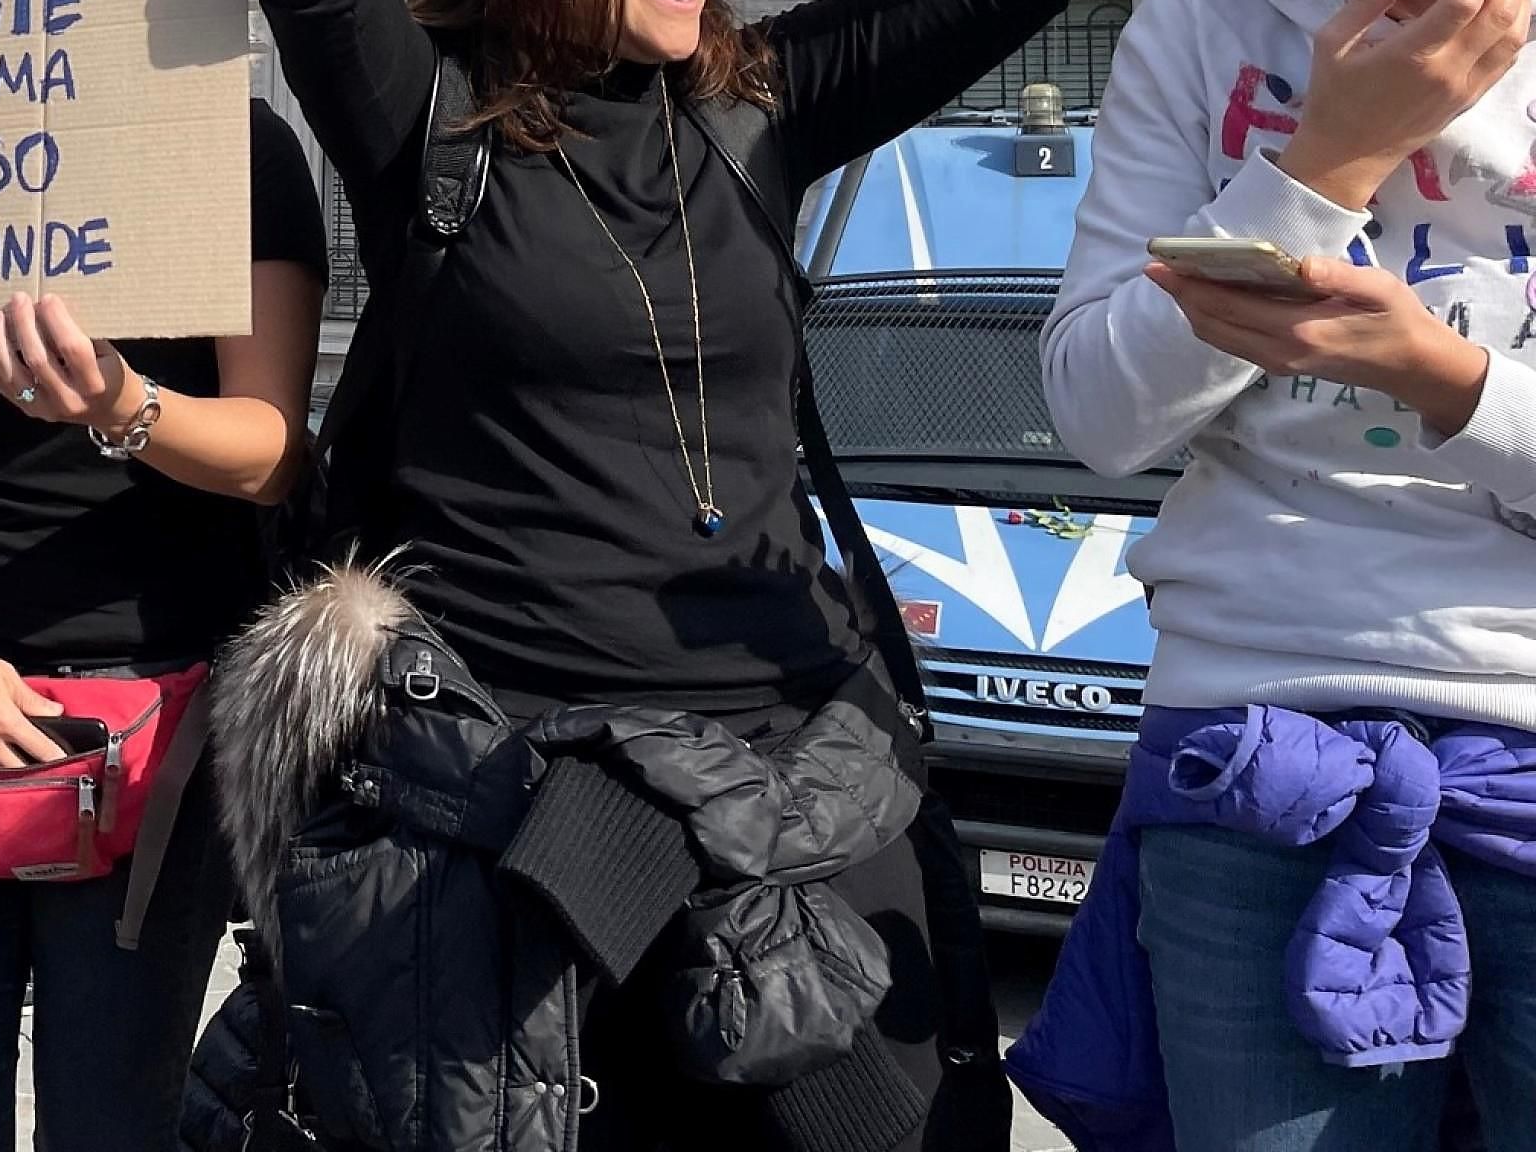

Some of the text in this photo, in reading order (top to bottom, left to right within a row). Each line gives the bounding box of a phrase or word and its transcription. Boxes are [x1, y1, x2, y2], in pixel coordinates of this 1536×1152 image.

[1038, 147, 1053, 170] 2
[976, 674, 1112, 711] IVECO
[1009, 854, 1086, 877] POLIZIA
[1011, 872, 1086, 901] F8242
